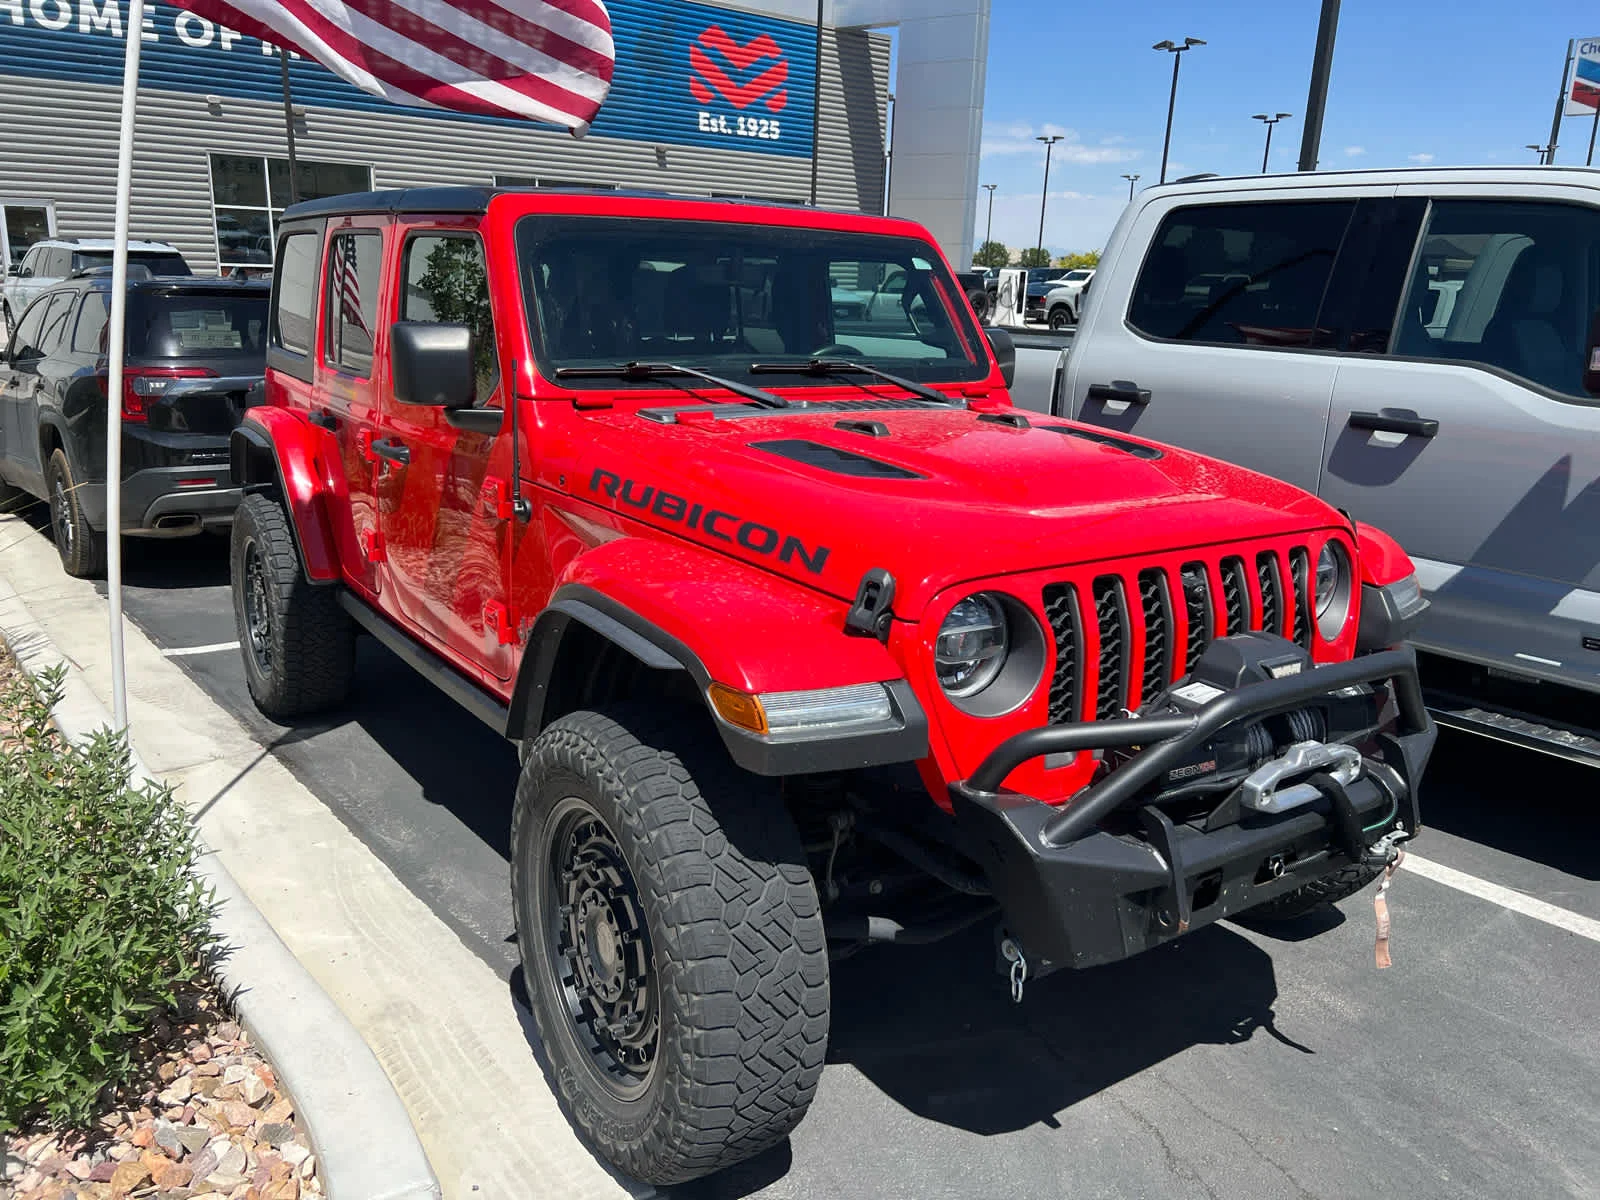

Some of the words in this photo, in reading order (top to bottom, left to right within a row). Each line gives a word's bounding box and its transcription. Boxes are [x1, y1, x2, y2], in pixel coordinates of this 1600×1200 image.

[698, 111, 732, 134] Est.
[736, 116, 780, 139] 1925
[589, 467, 832, 574] RUBICON
